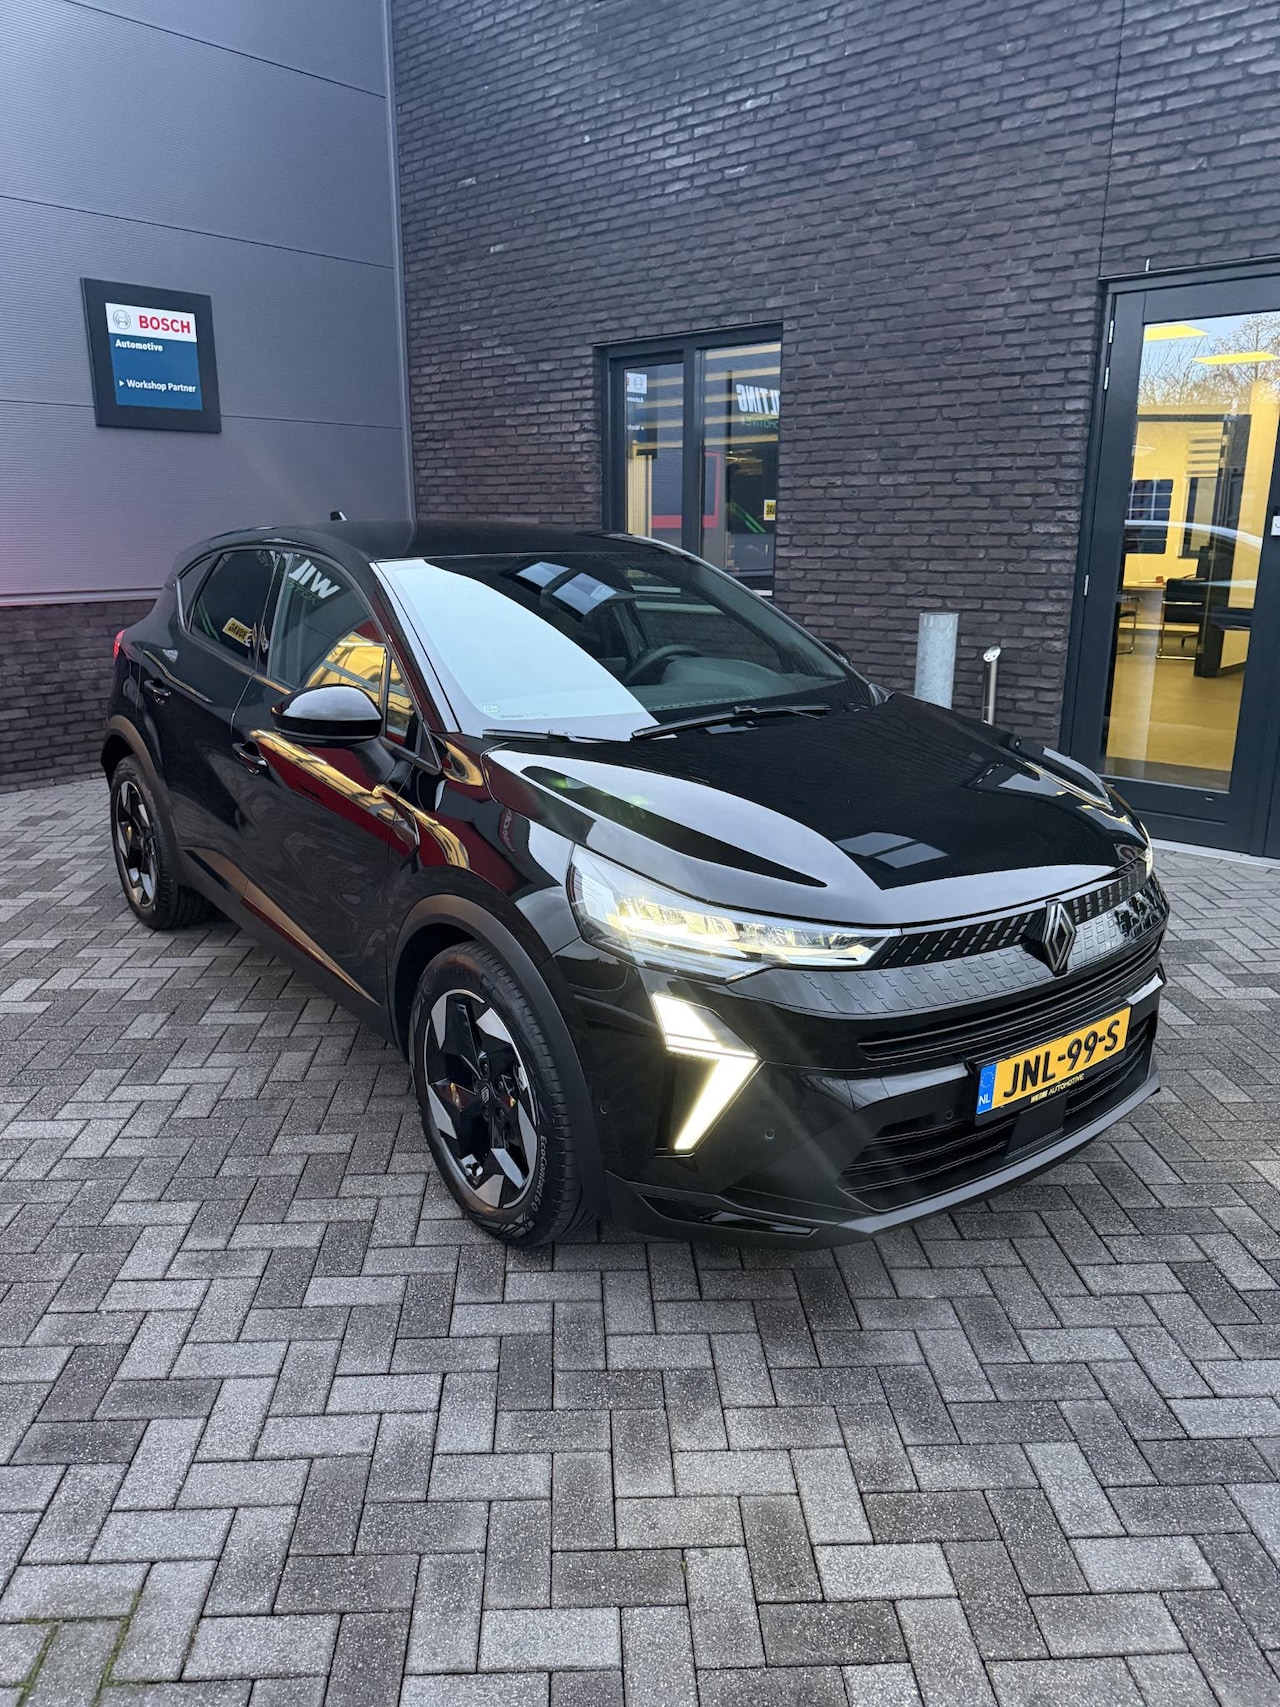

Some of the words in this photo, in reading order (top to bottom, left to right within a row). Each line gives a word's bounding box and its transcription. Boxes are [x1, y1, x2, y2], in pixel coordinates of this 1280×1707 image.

[139, 315, 190, 333] BOSCH
[115, 339, 163, 351] Automotive
[126, 379, 167, 392] Workshop
[168, 382, 196, 393] Partner
[1003, 1019, 1120, 1098] JNL-99-S
[1048, 1072, 1085, 1096] AUTOMOTIVE
[978, 1093, 991, 1106] NL
[535, 1135, 547, 1197] EcoContact
